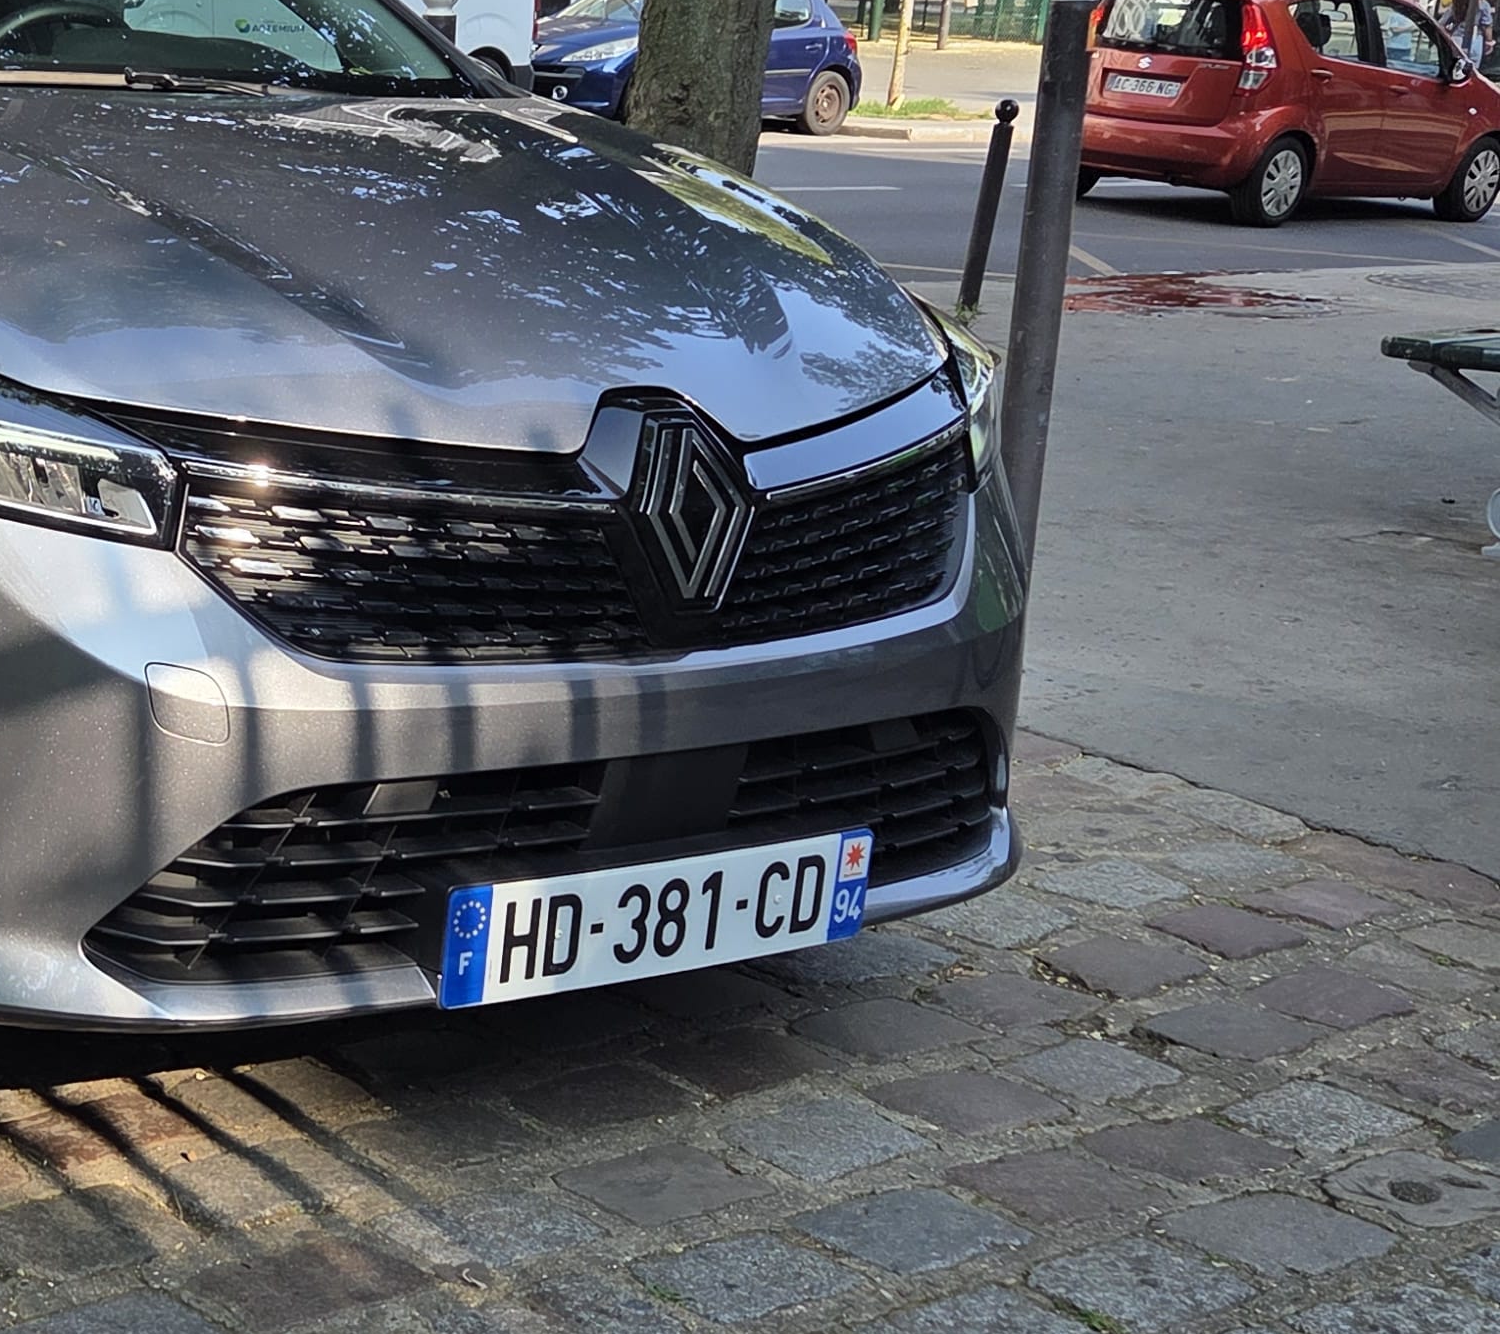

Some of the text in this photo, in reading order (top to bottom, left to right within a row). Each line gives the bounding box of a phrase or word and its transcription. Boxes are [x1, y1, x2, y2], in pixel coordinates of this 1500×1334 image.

[457, 854, 862, 985] F HD-381-CD 94
